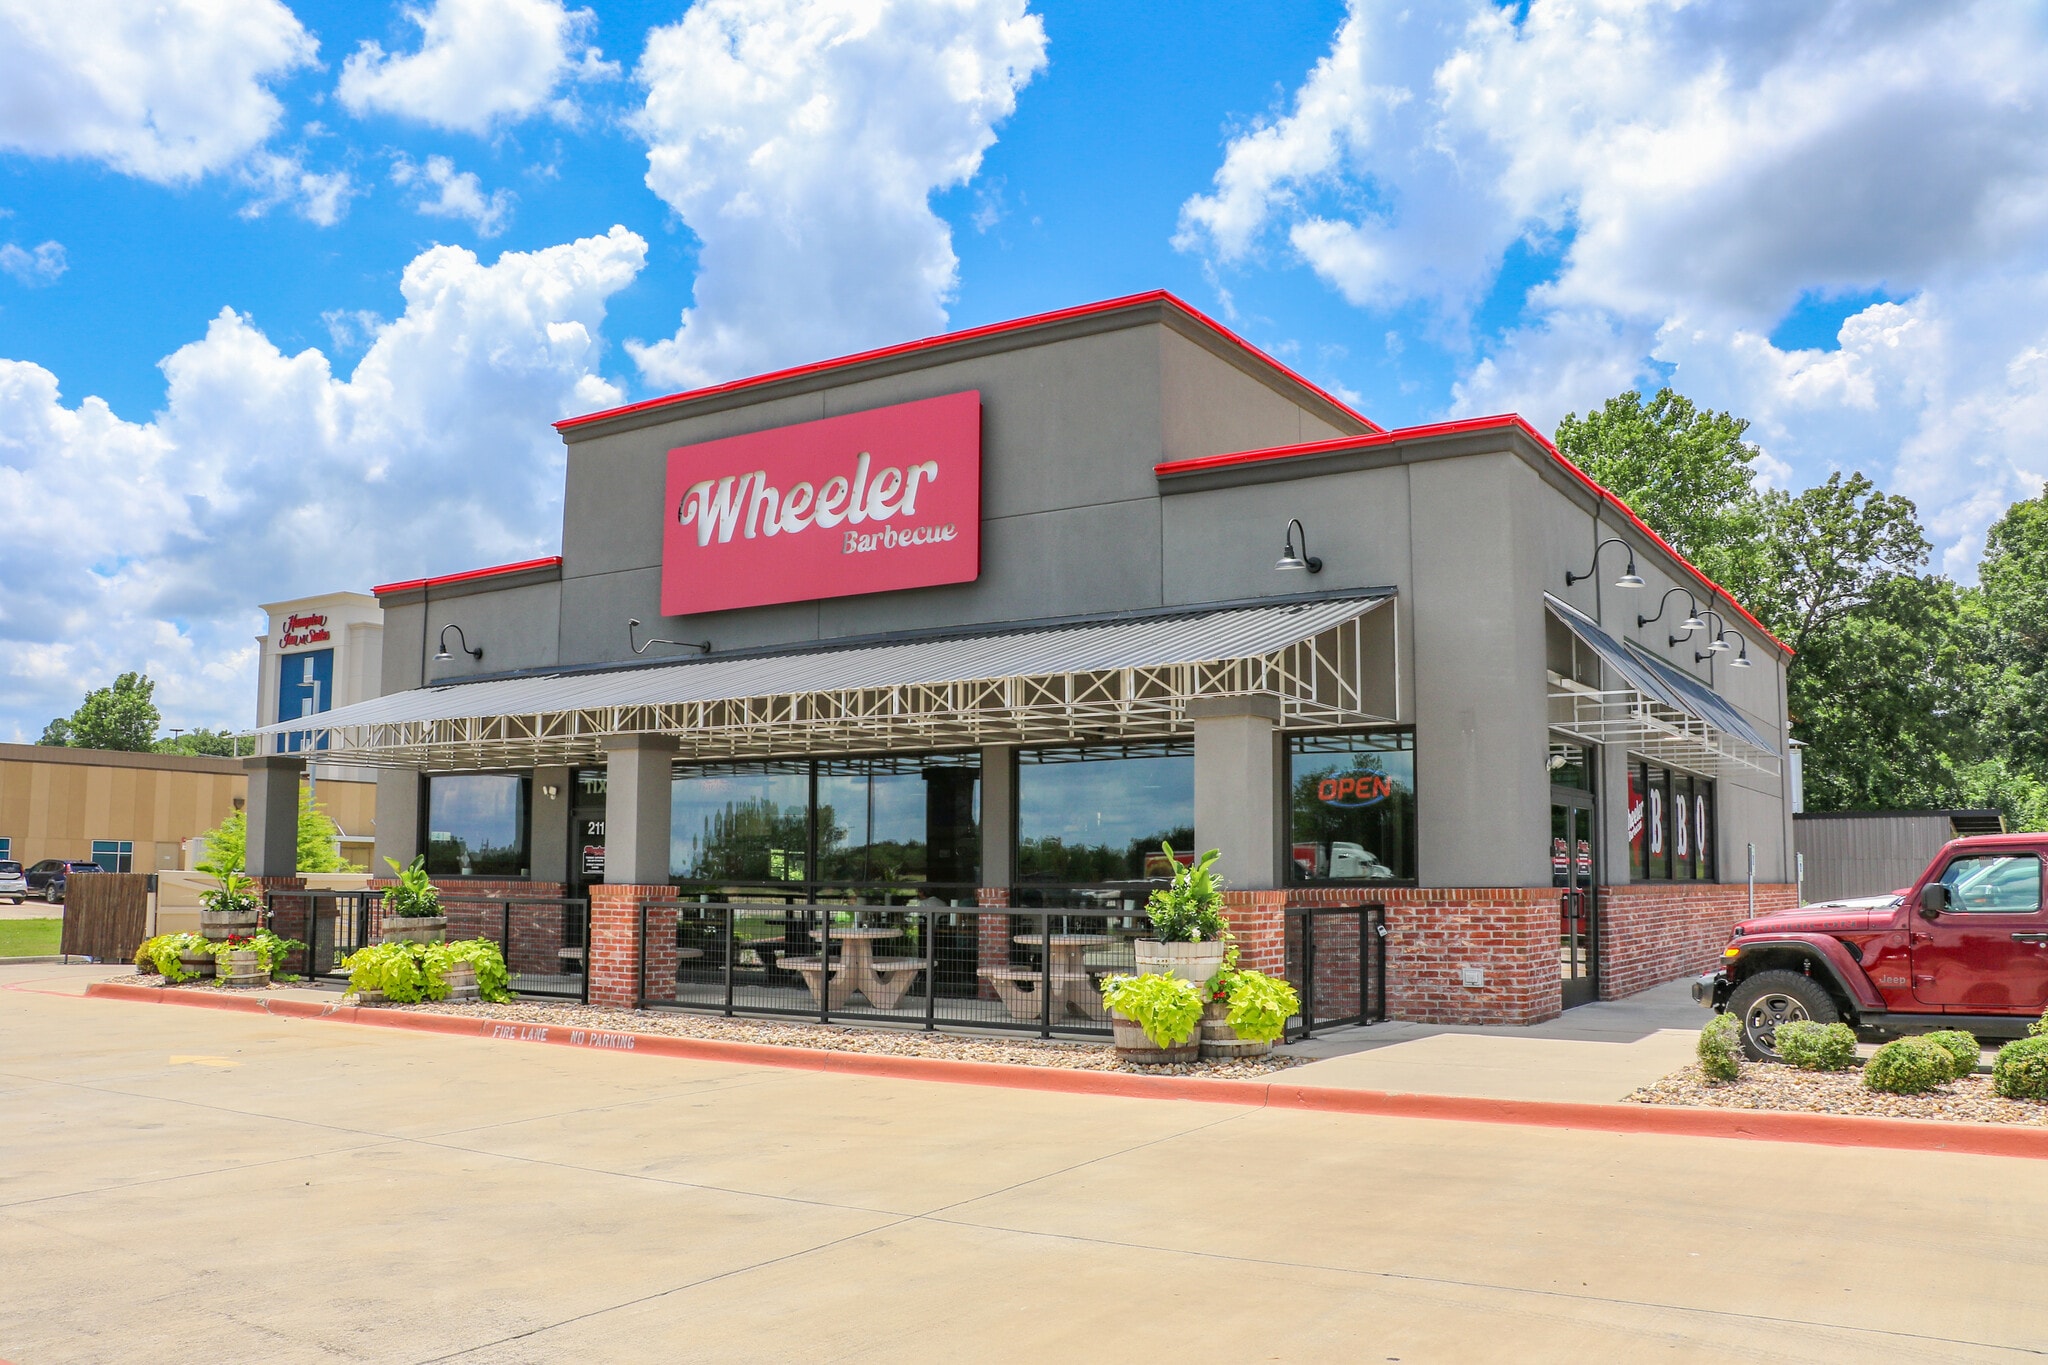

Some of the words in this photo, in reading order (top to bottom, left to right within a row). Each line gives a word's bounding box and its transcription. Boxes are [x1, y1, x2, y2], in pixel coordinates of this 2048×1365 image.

[678, 451, 938, 547] Wheeler
[842, 522, 958, 554] Barbecue
[283, 613, 327, 633] Hampton
[1318, 776, 1391, 801] OPEN
[1879, 974, 1907, 985] Jeep
[492, 1025, 515, 1039] FIRE
[520, 1026, 549, 1042] LANE
[570, 1030, 585, 1045] NO
[588, 1032, 635, 1050] PARKING
